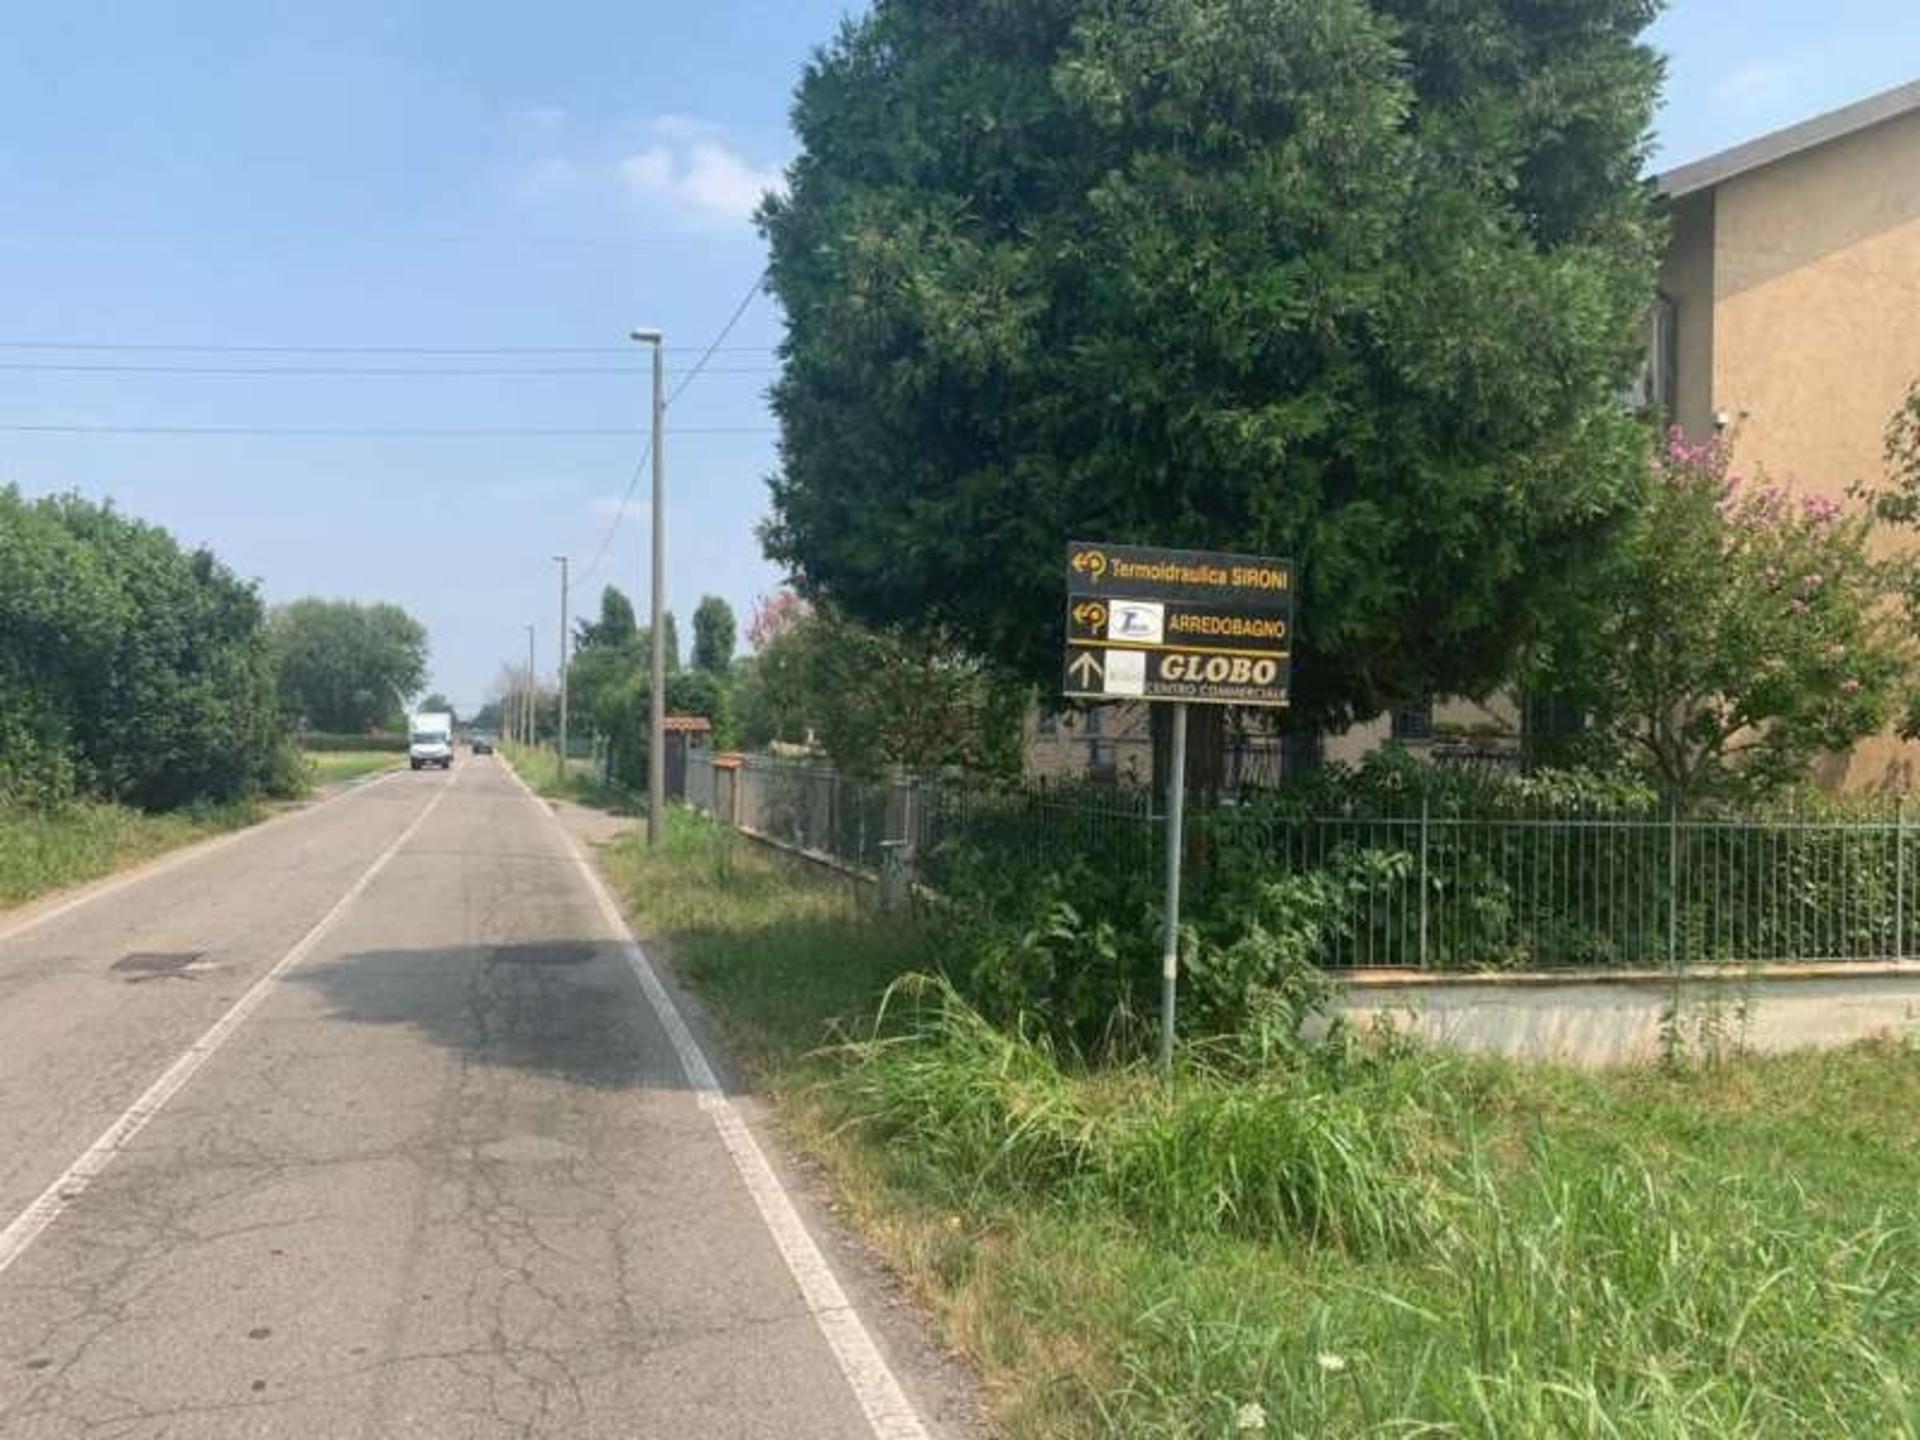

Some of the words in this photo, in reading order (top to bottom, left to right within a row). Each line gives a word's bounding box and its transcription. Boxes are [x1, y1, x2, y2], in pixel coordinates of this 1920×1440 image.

[1111, 558, 1227, 584] Termoidraulica
[1231, 567, 1287, 590] SIRONI
[1168, 614, 1285, 637] ARREDOBAGNO
[1160, 655, 1277, 684] GLOBO
